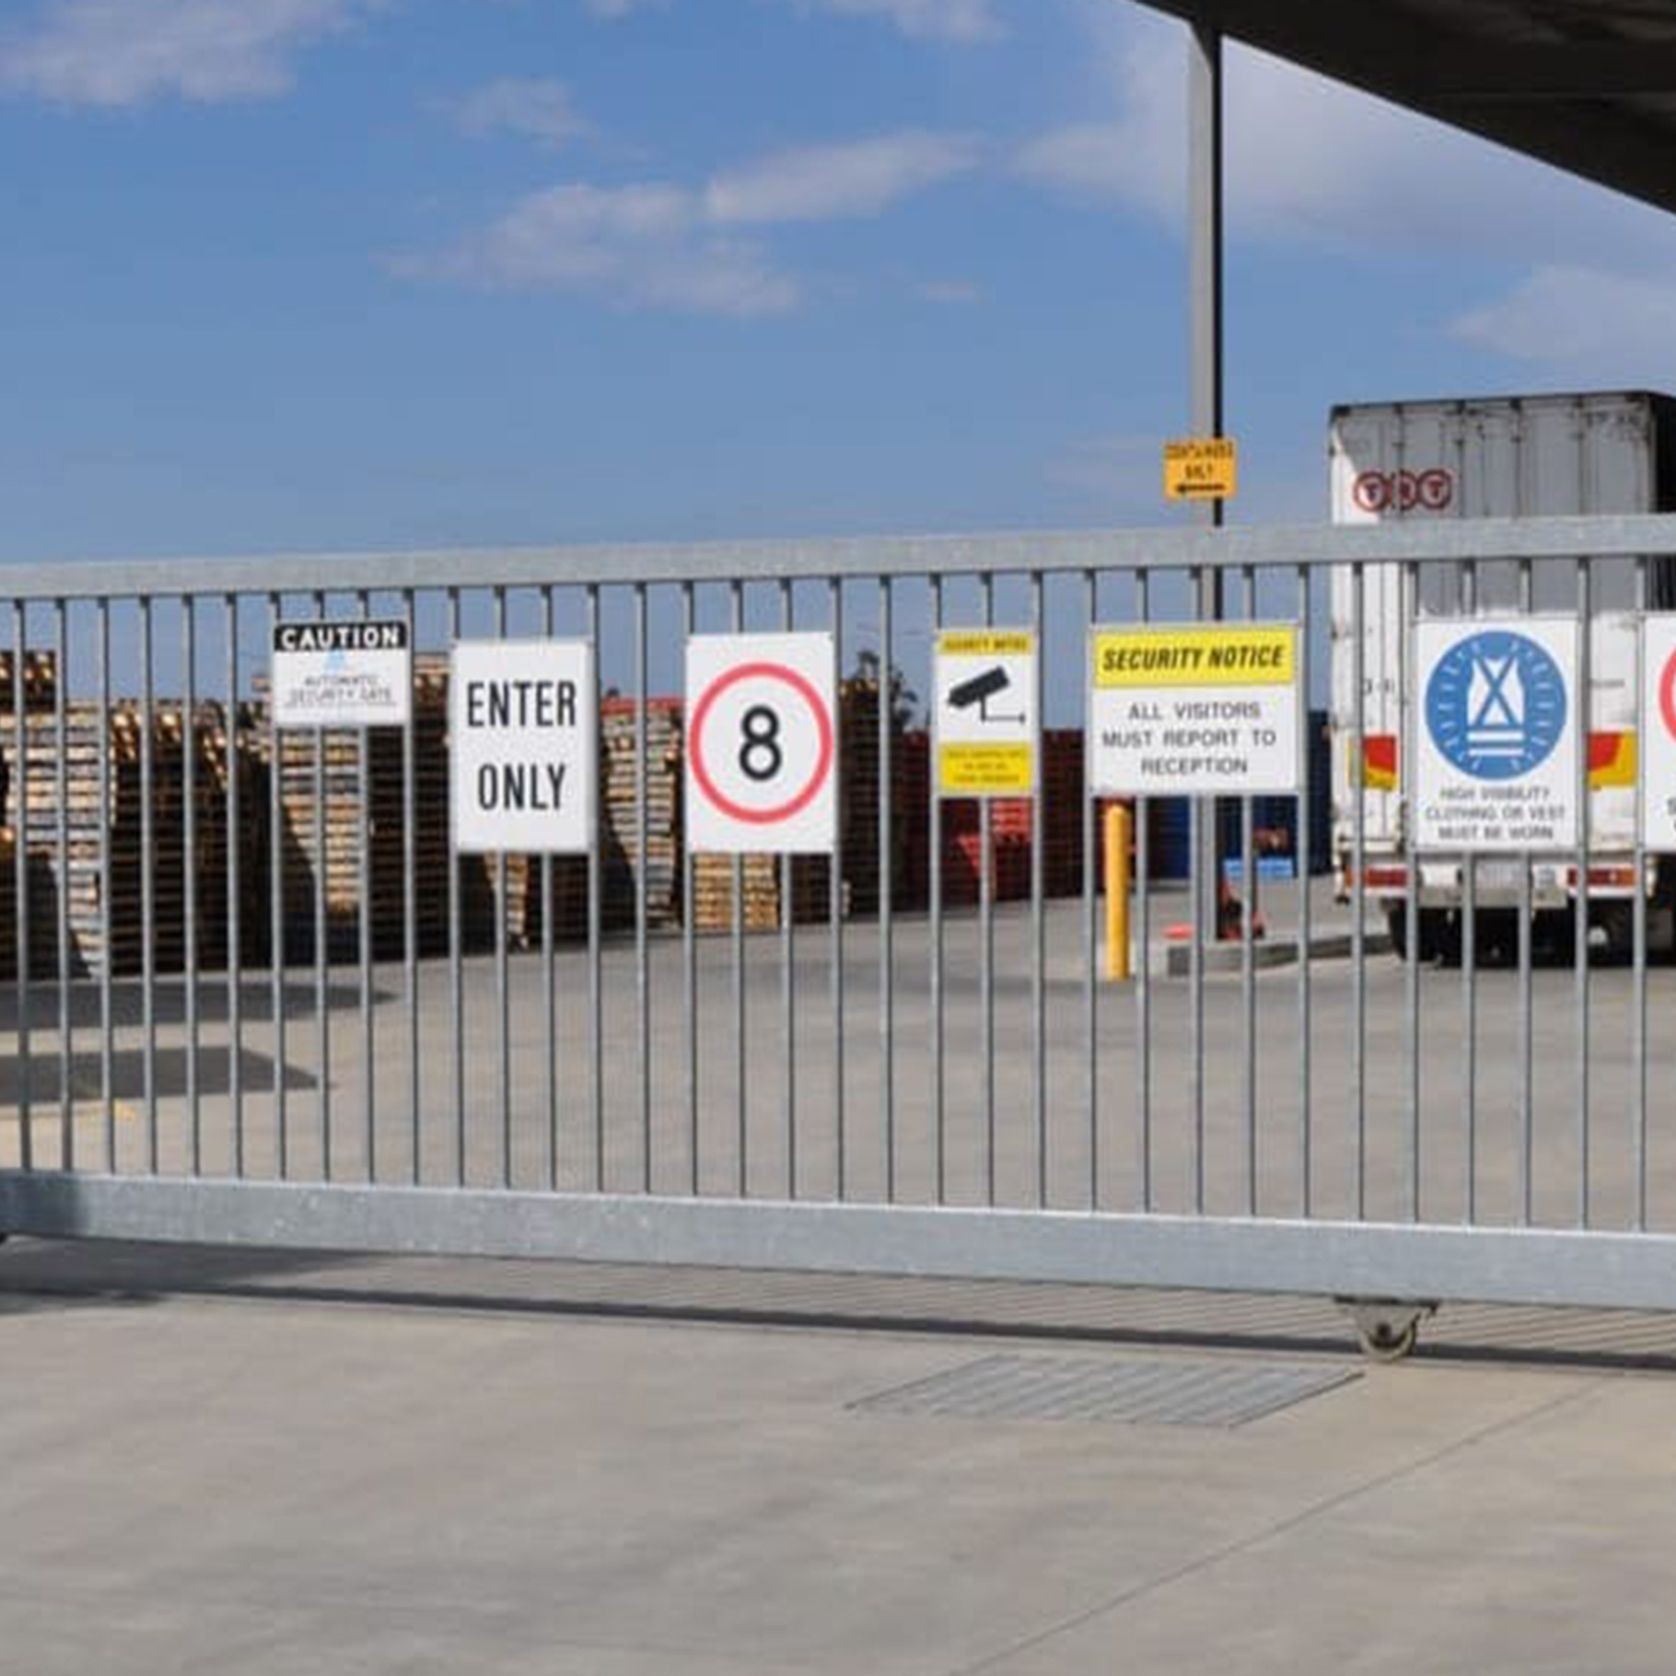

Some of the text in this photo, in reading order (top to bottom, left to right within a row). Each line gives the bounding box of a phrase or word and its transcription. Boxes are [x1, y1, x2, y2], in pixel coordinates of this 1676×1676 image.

[281, 625, 399, 650] CAUTION
[1102, 644, 1285, 672] SECURITY NOTICE
[467, 680, 576, 728] ENTER
[1128, 701, 1262, 720] ALL VISITORS
[739, 704, 782, 783] 8
[1102, 729, 1278, 749] MUST REPORT TO
[1140, 757, 1249, 776] RECEPTION
[478, 762, 566, 811] ONLY
